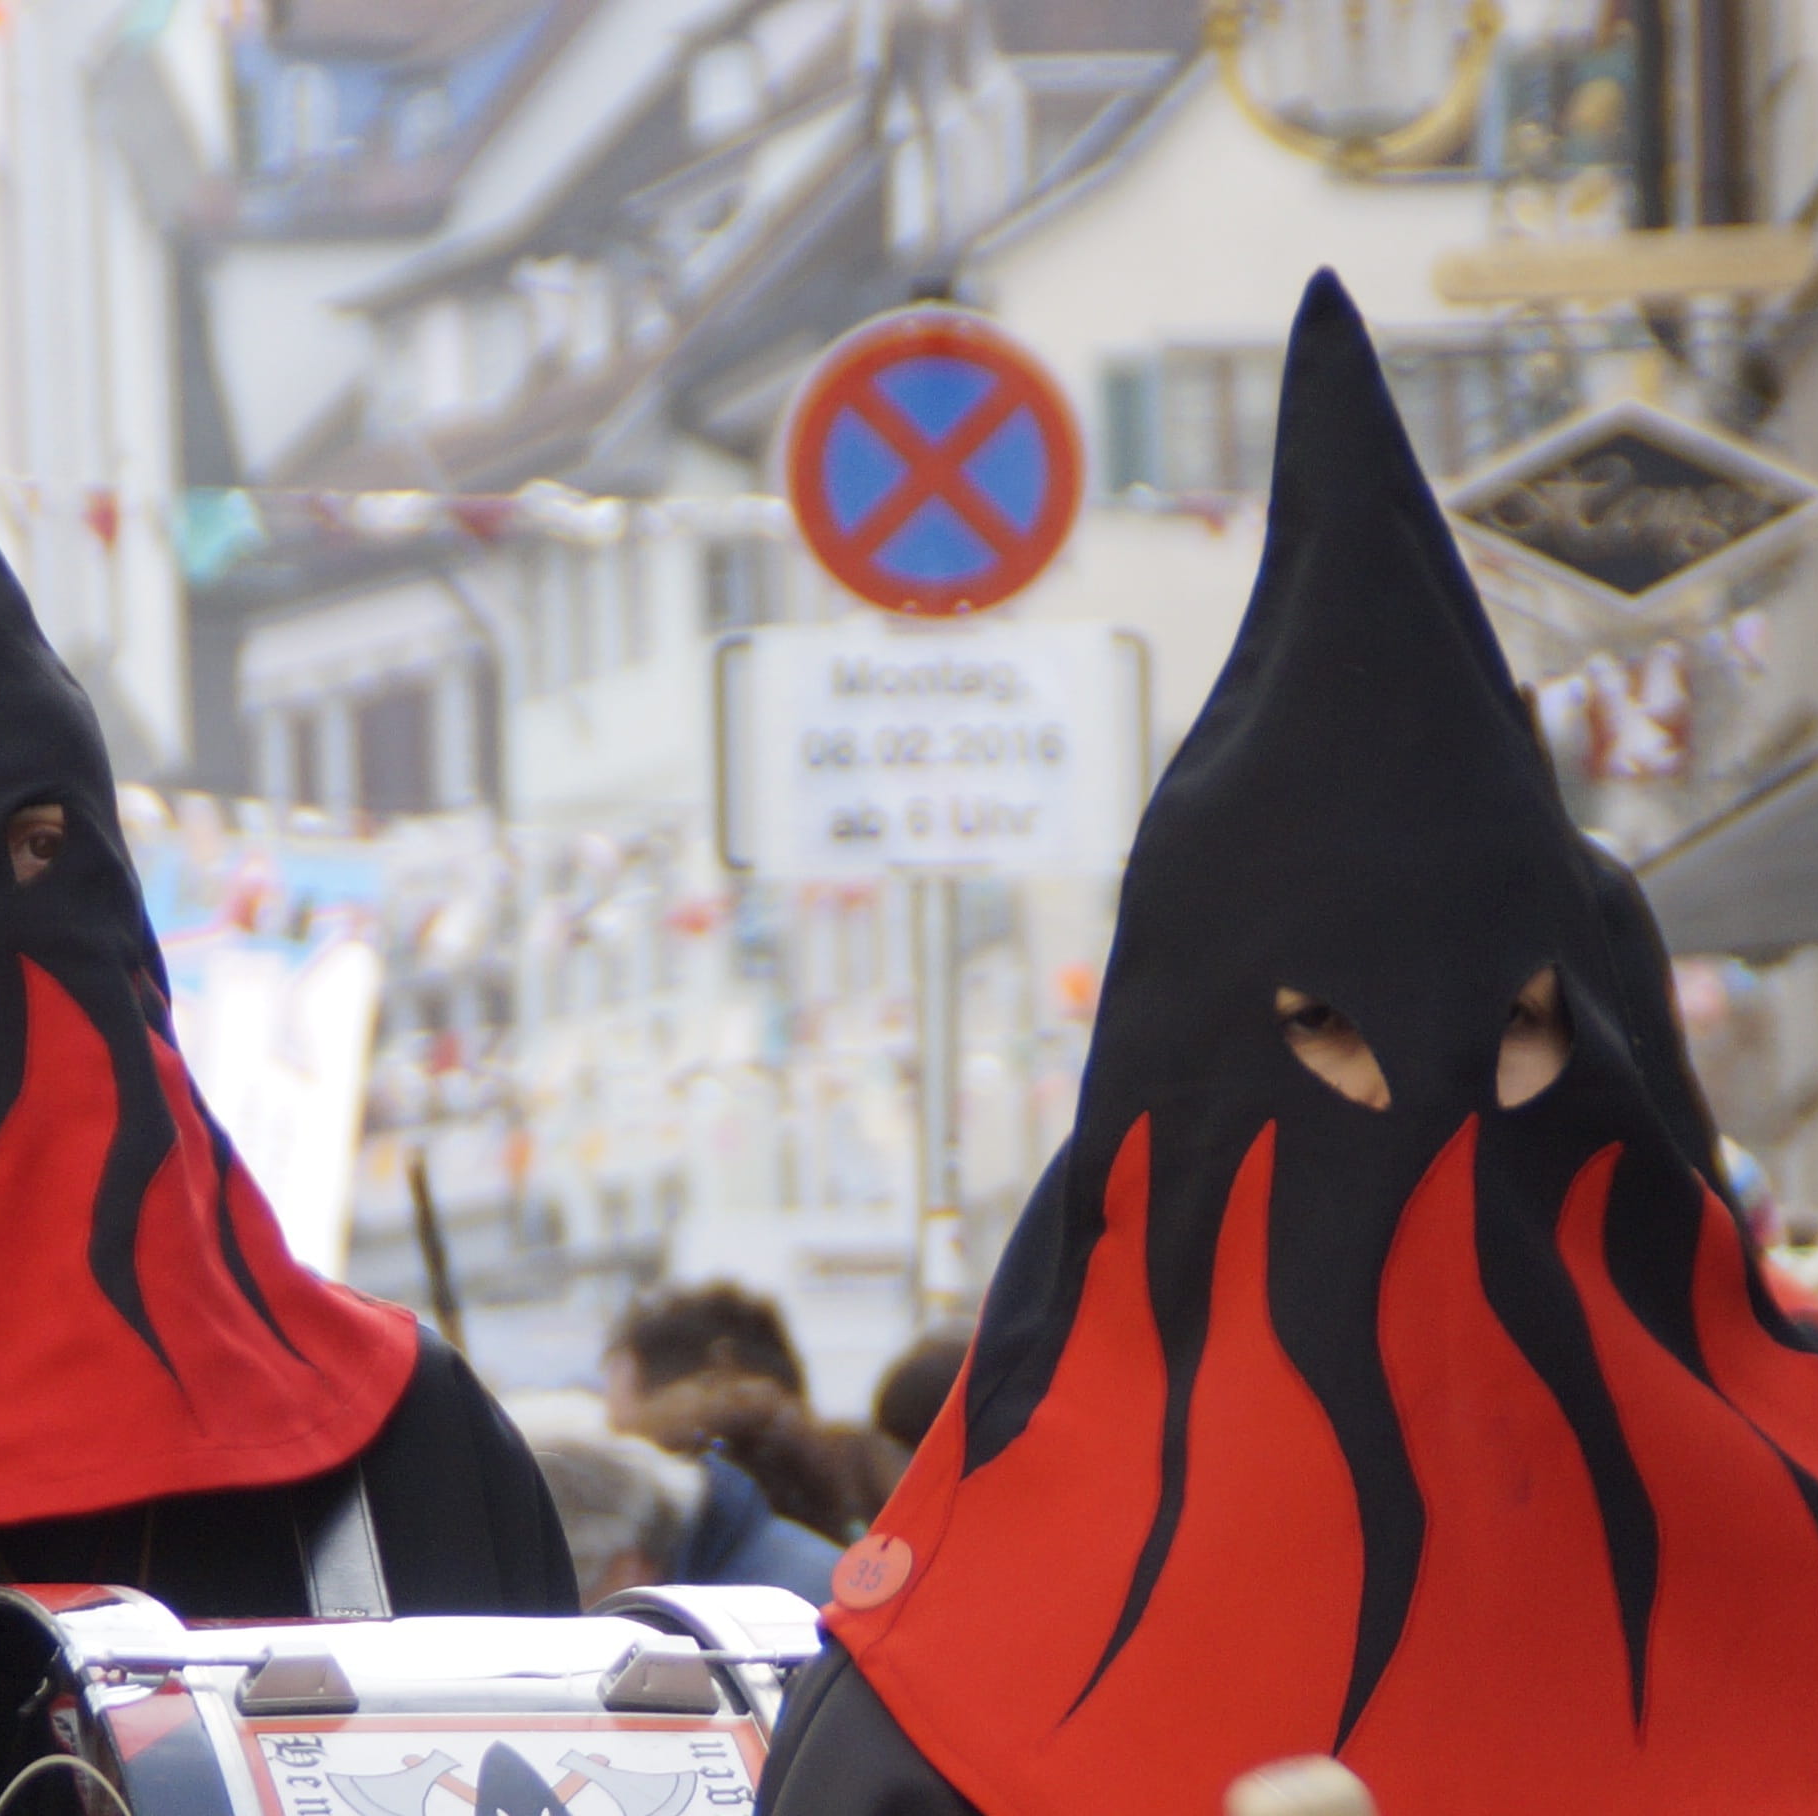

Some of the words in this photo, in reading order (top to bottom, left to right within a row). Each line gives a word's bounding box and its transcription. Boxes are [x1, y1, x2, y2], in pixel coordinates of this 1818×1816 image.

[830, 798, 889, 842] ab
[950, 793, 1043, 838] Uhr
[846, 1557, 889, 1592] 35
